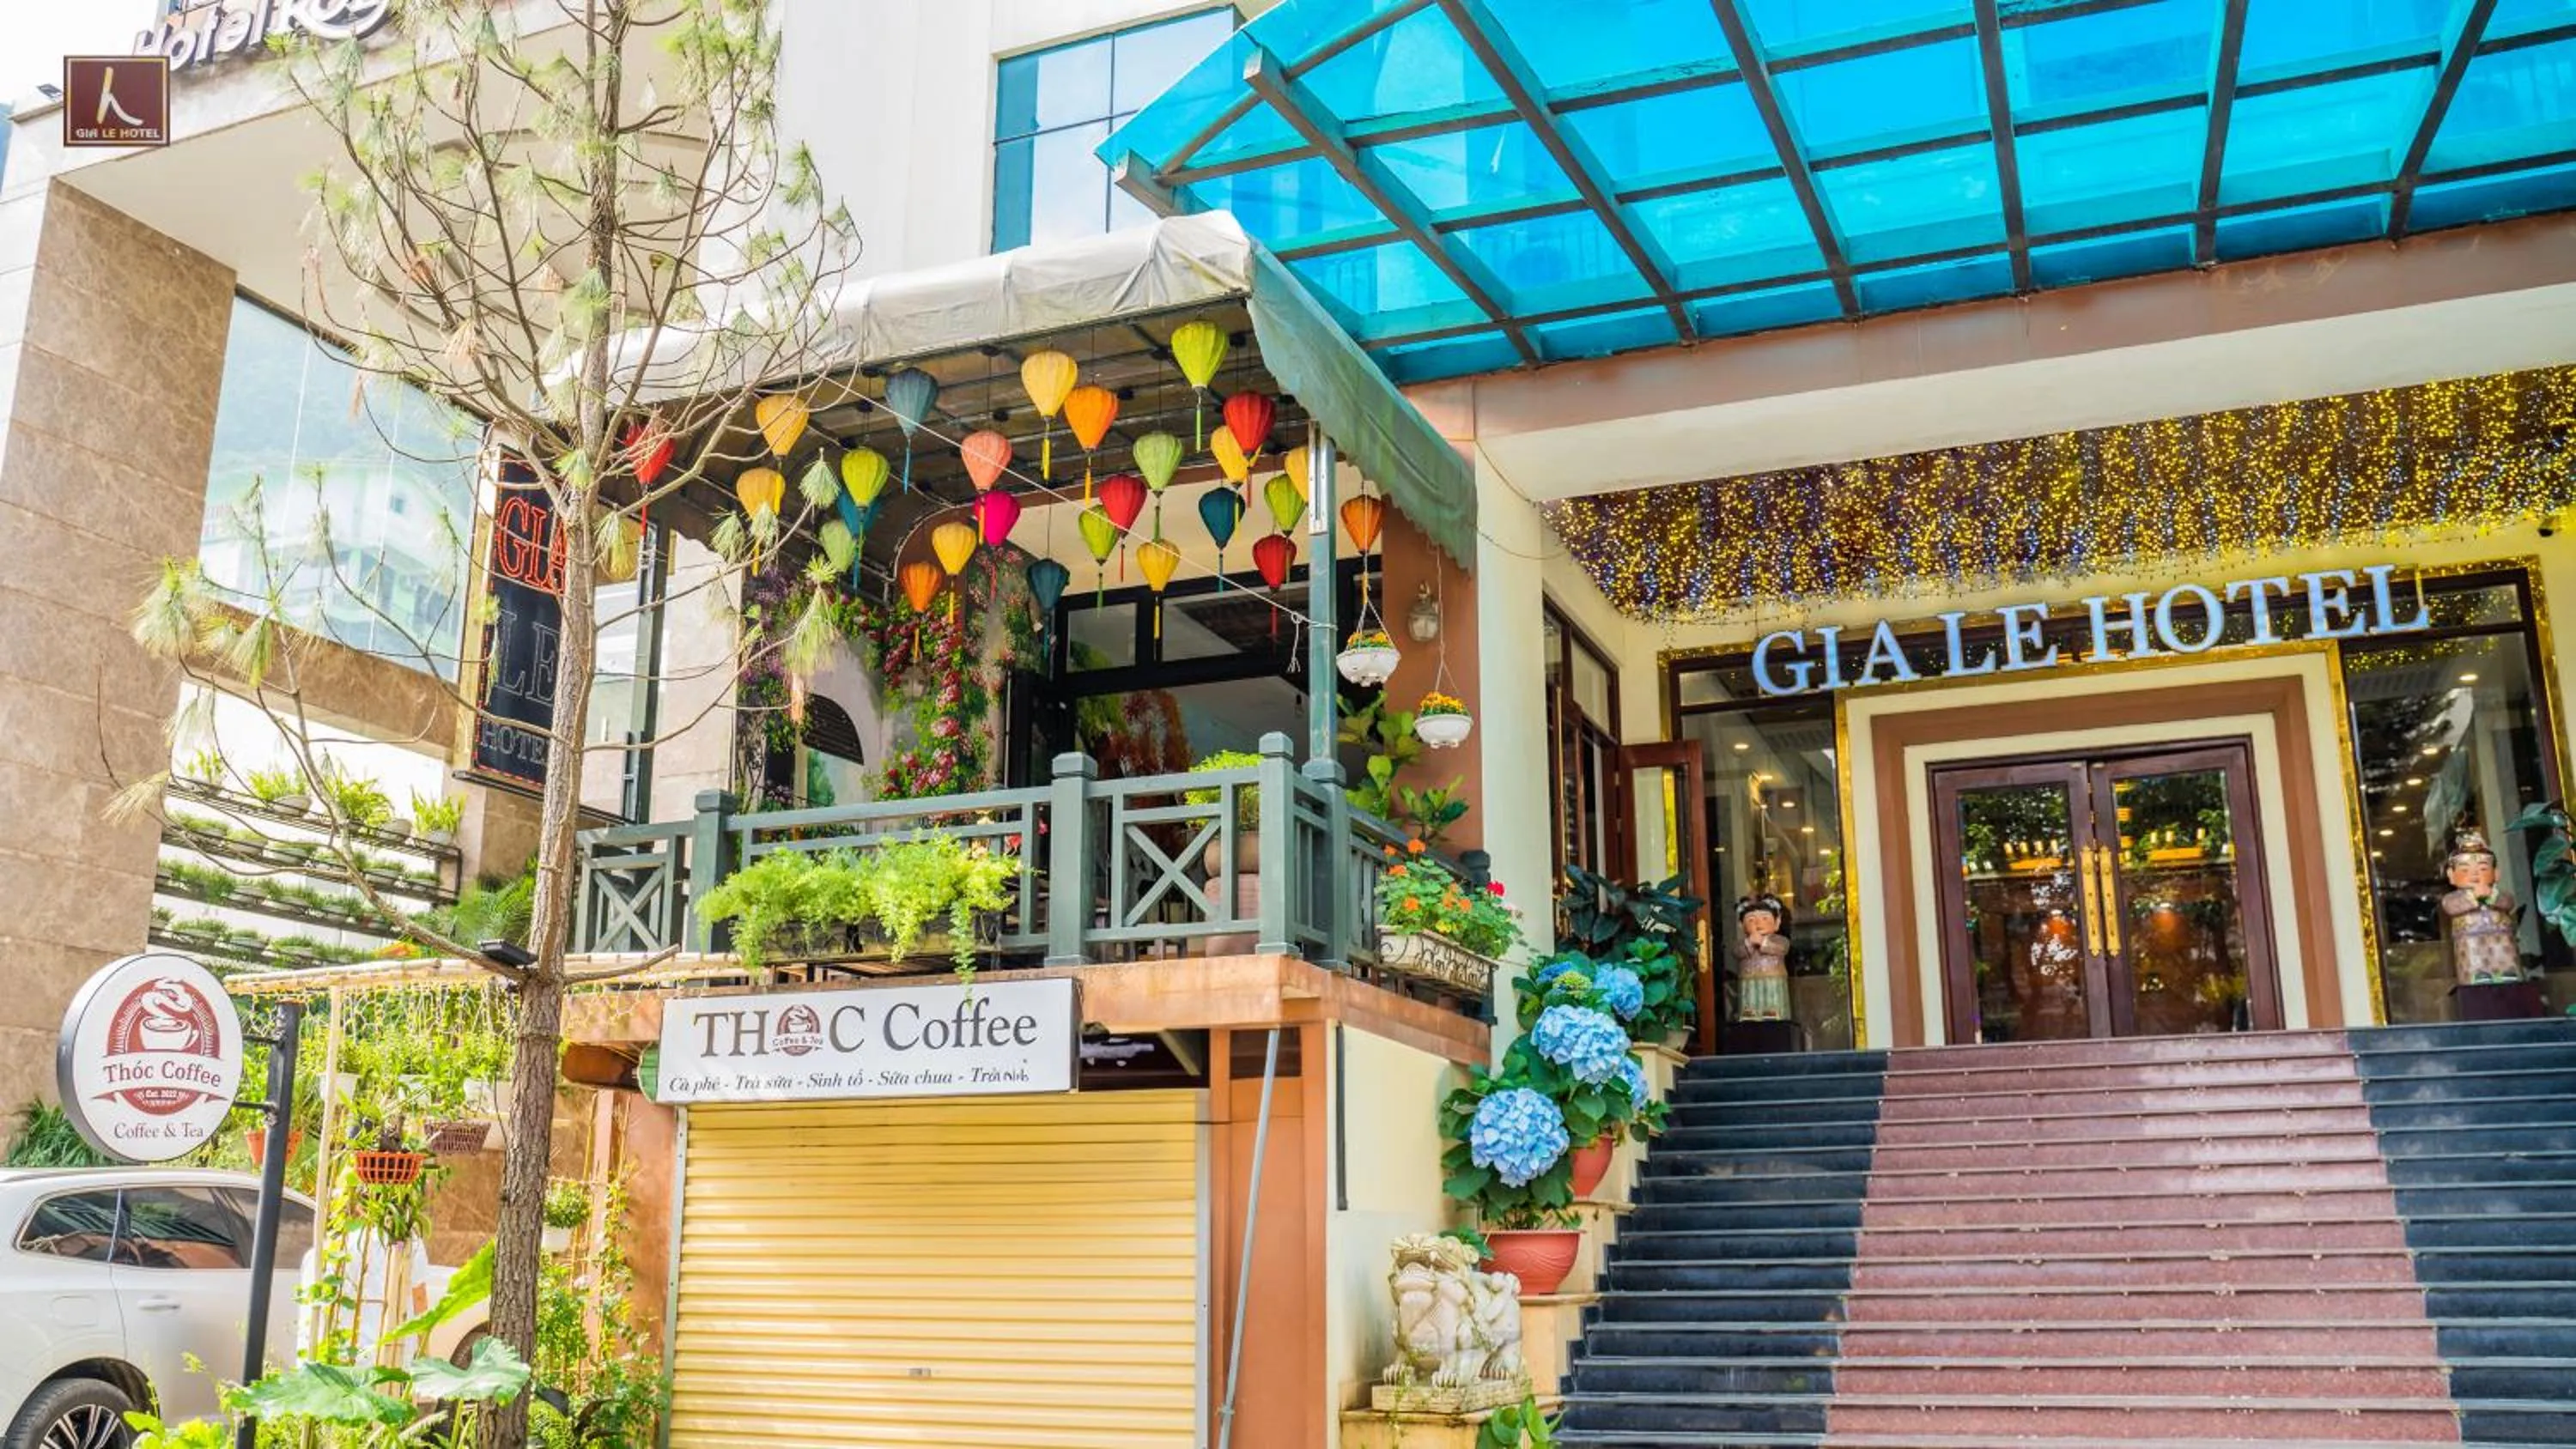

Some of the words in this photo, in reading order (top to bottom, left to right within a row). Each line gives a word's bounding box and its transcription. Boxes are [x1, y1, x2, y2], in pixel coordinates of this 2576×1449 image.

[1752, 618, 1922, 696] GIA
[1937, 603, 2058, 676] LE
[2081, 564, 2430, 663] HOTEL
[498, 609, 560, 706] LE
[481, 718, 550, 767] HOTE
[883, 997, 1037, 1052] Coffee
[103, 1060, 154, 1083] Thóc
[161, 1061, 221, 1087] Coffee
[806, 1072, 841, 1088] Sinh
[113, 1122, 159, 1139] Coffee
[163, 1124, 177, 1138] &
[181, 1122, 204, 1138] Tea
